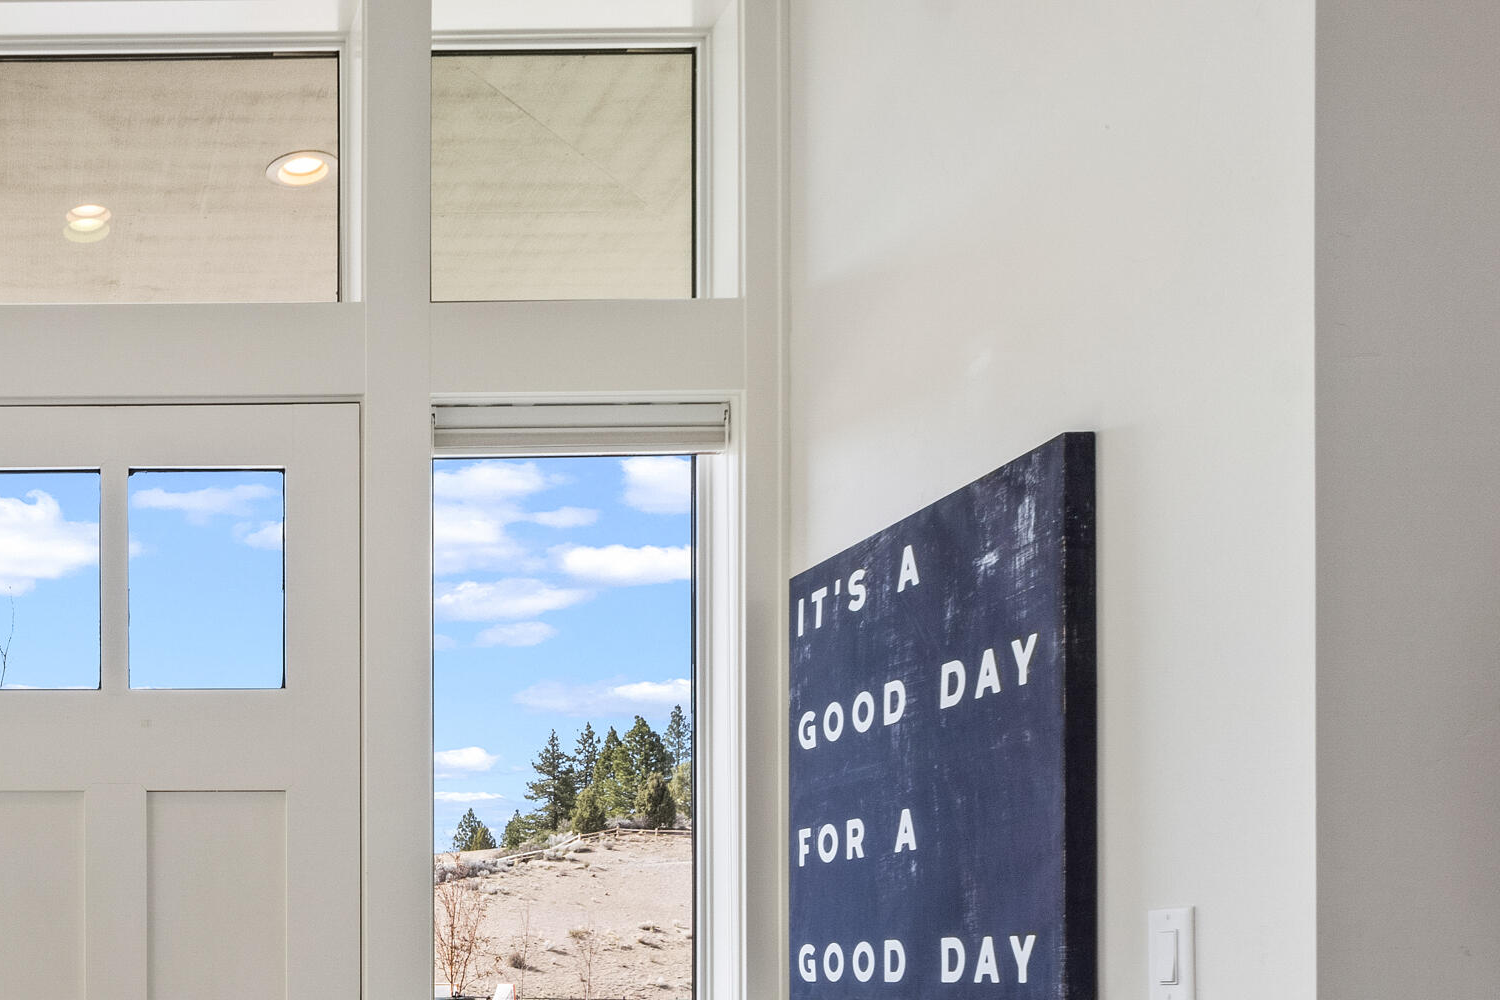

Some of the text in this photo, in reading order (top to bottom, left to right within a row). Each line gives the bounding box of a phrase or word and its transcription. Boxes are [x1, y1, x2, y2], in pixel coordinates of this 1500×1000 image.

[797, 544, 920, 637] IT'S A
[798, 632, 1038, 750] GOOD DAY
[798, 808, 918, 867] FOR A
[798, 934, 1037, 984] GOOD DAY
